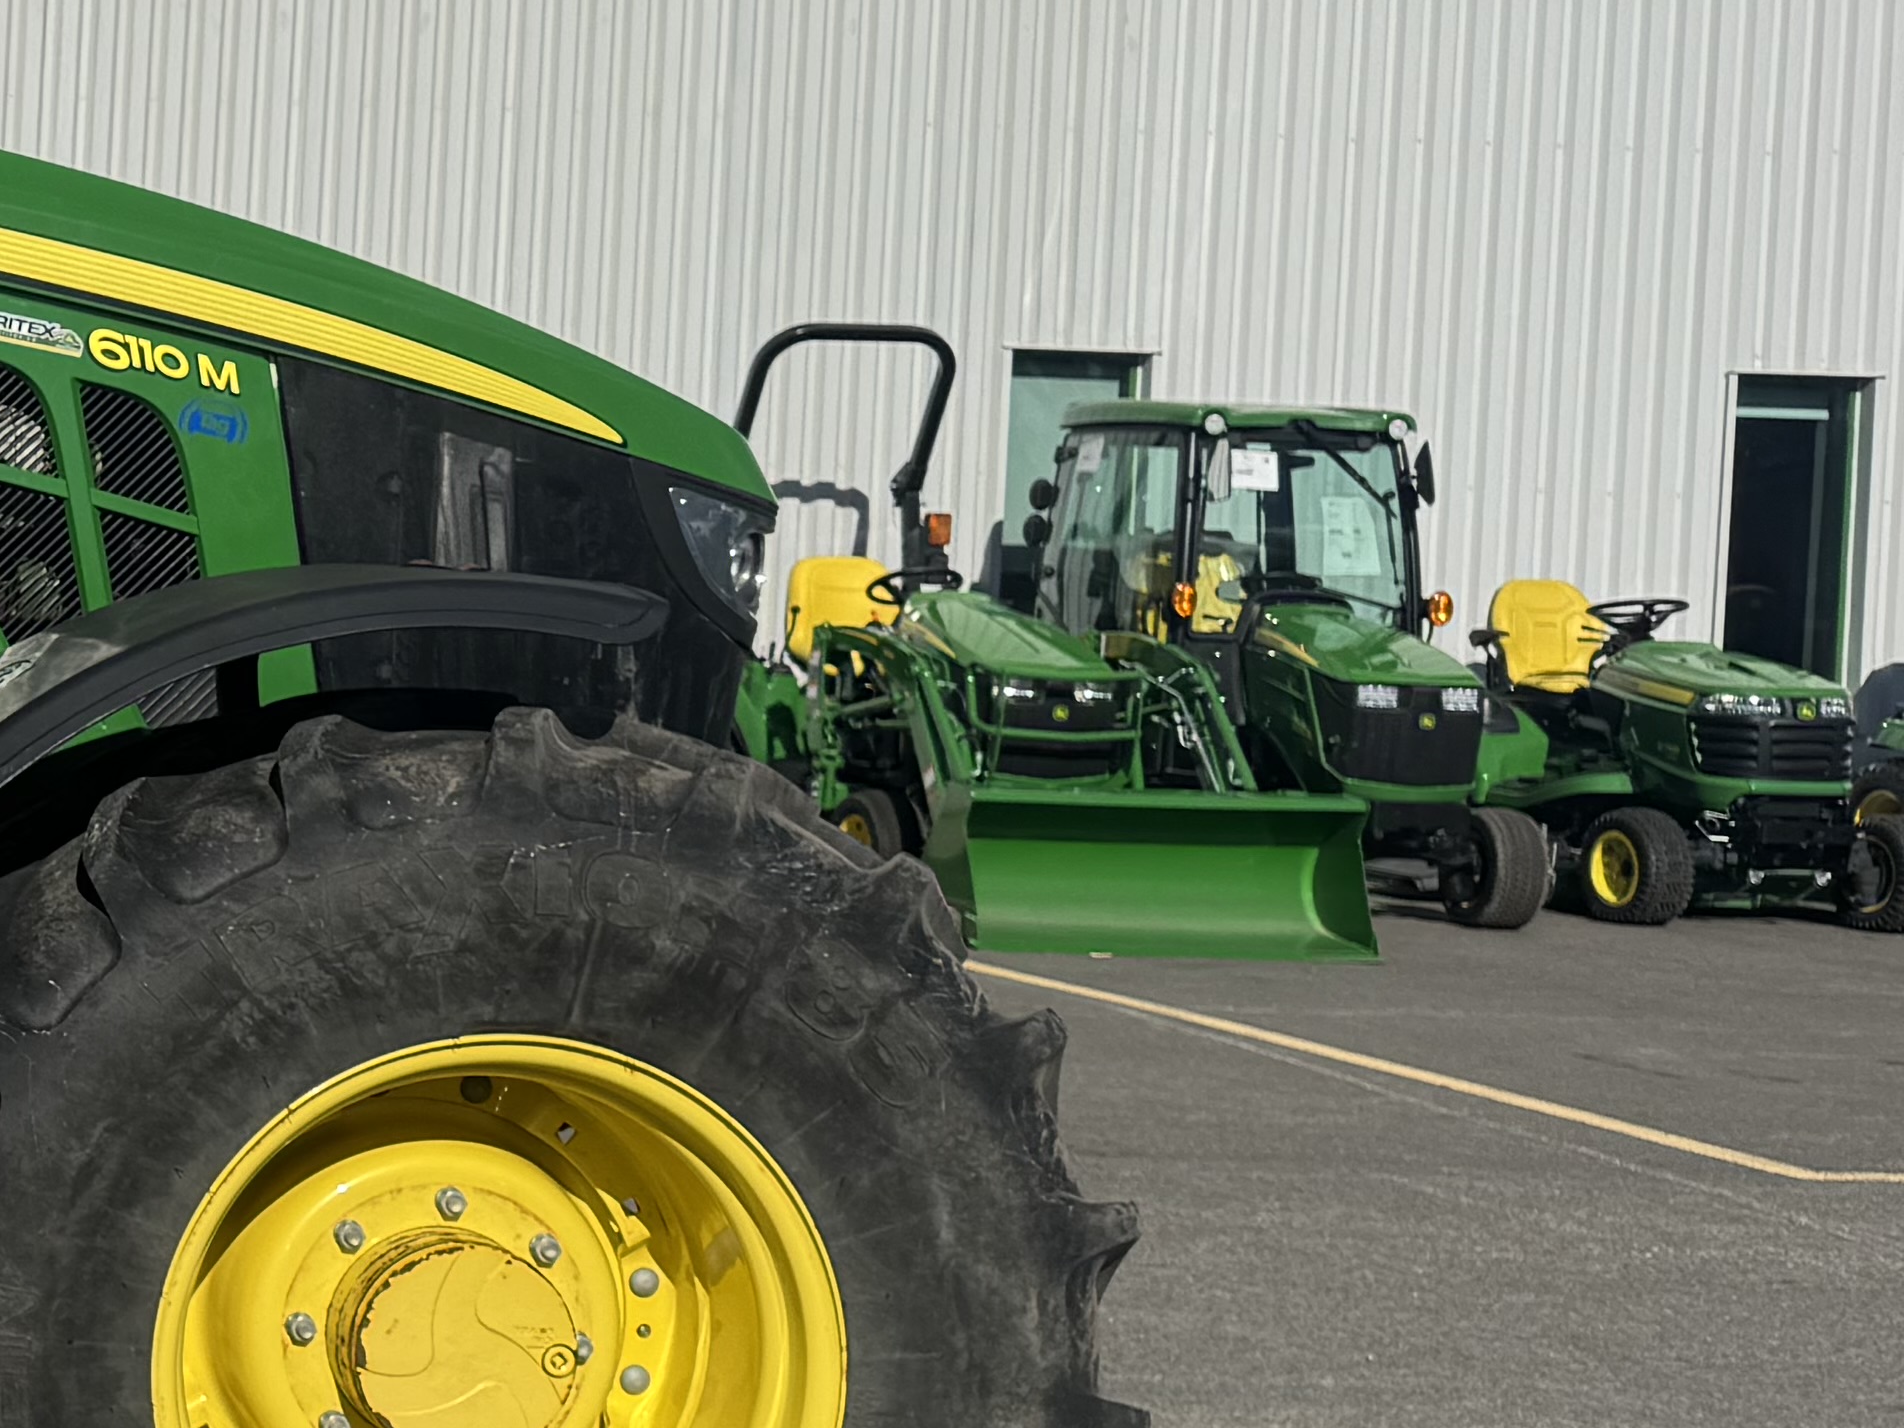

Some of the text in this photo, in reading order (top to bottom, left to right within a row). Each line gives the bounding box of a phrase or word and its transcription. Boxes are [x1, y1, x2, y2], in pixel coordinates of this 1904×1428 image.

[88, 328, 190, 379] 6110
[197, 353, 241, 394] M
[772, 926, 967, 1120] 85
